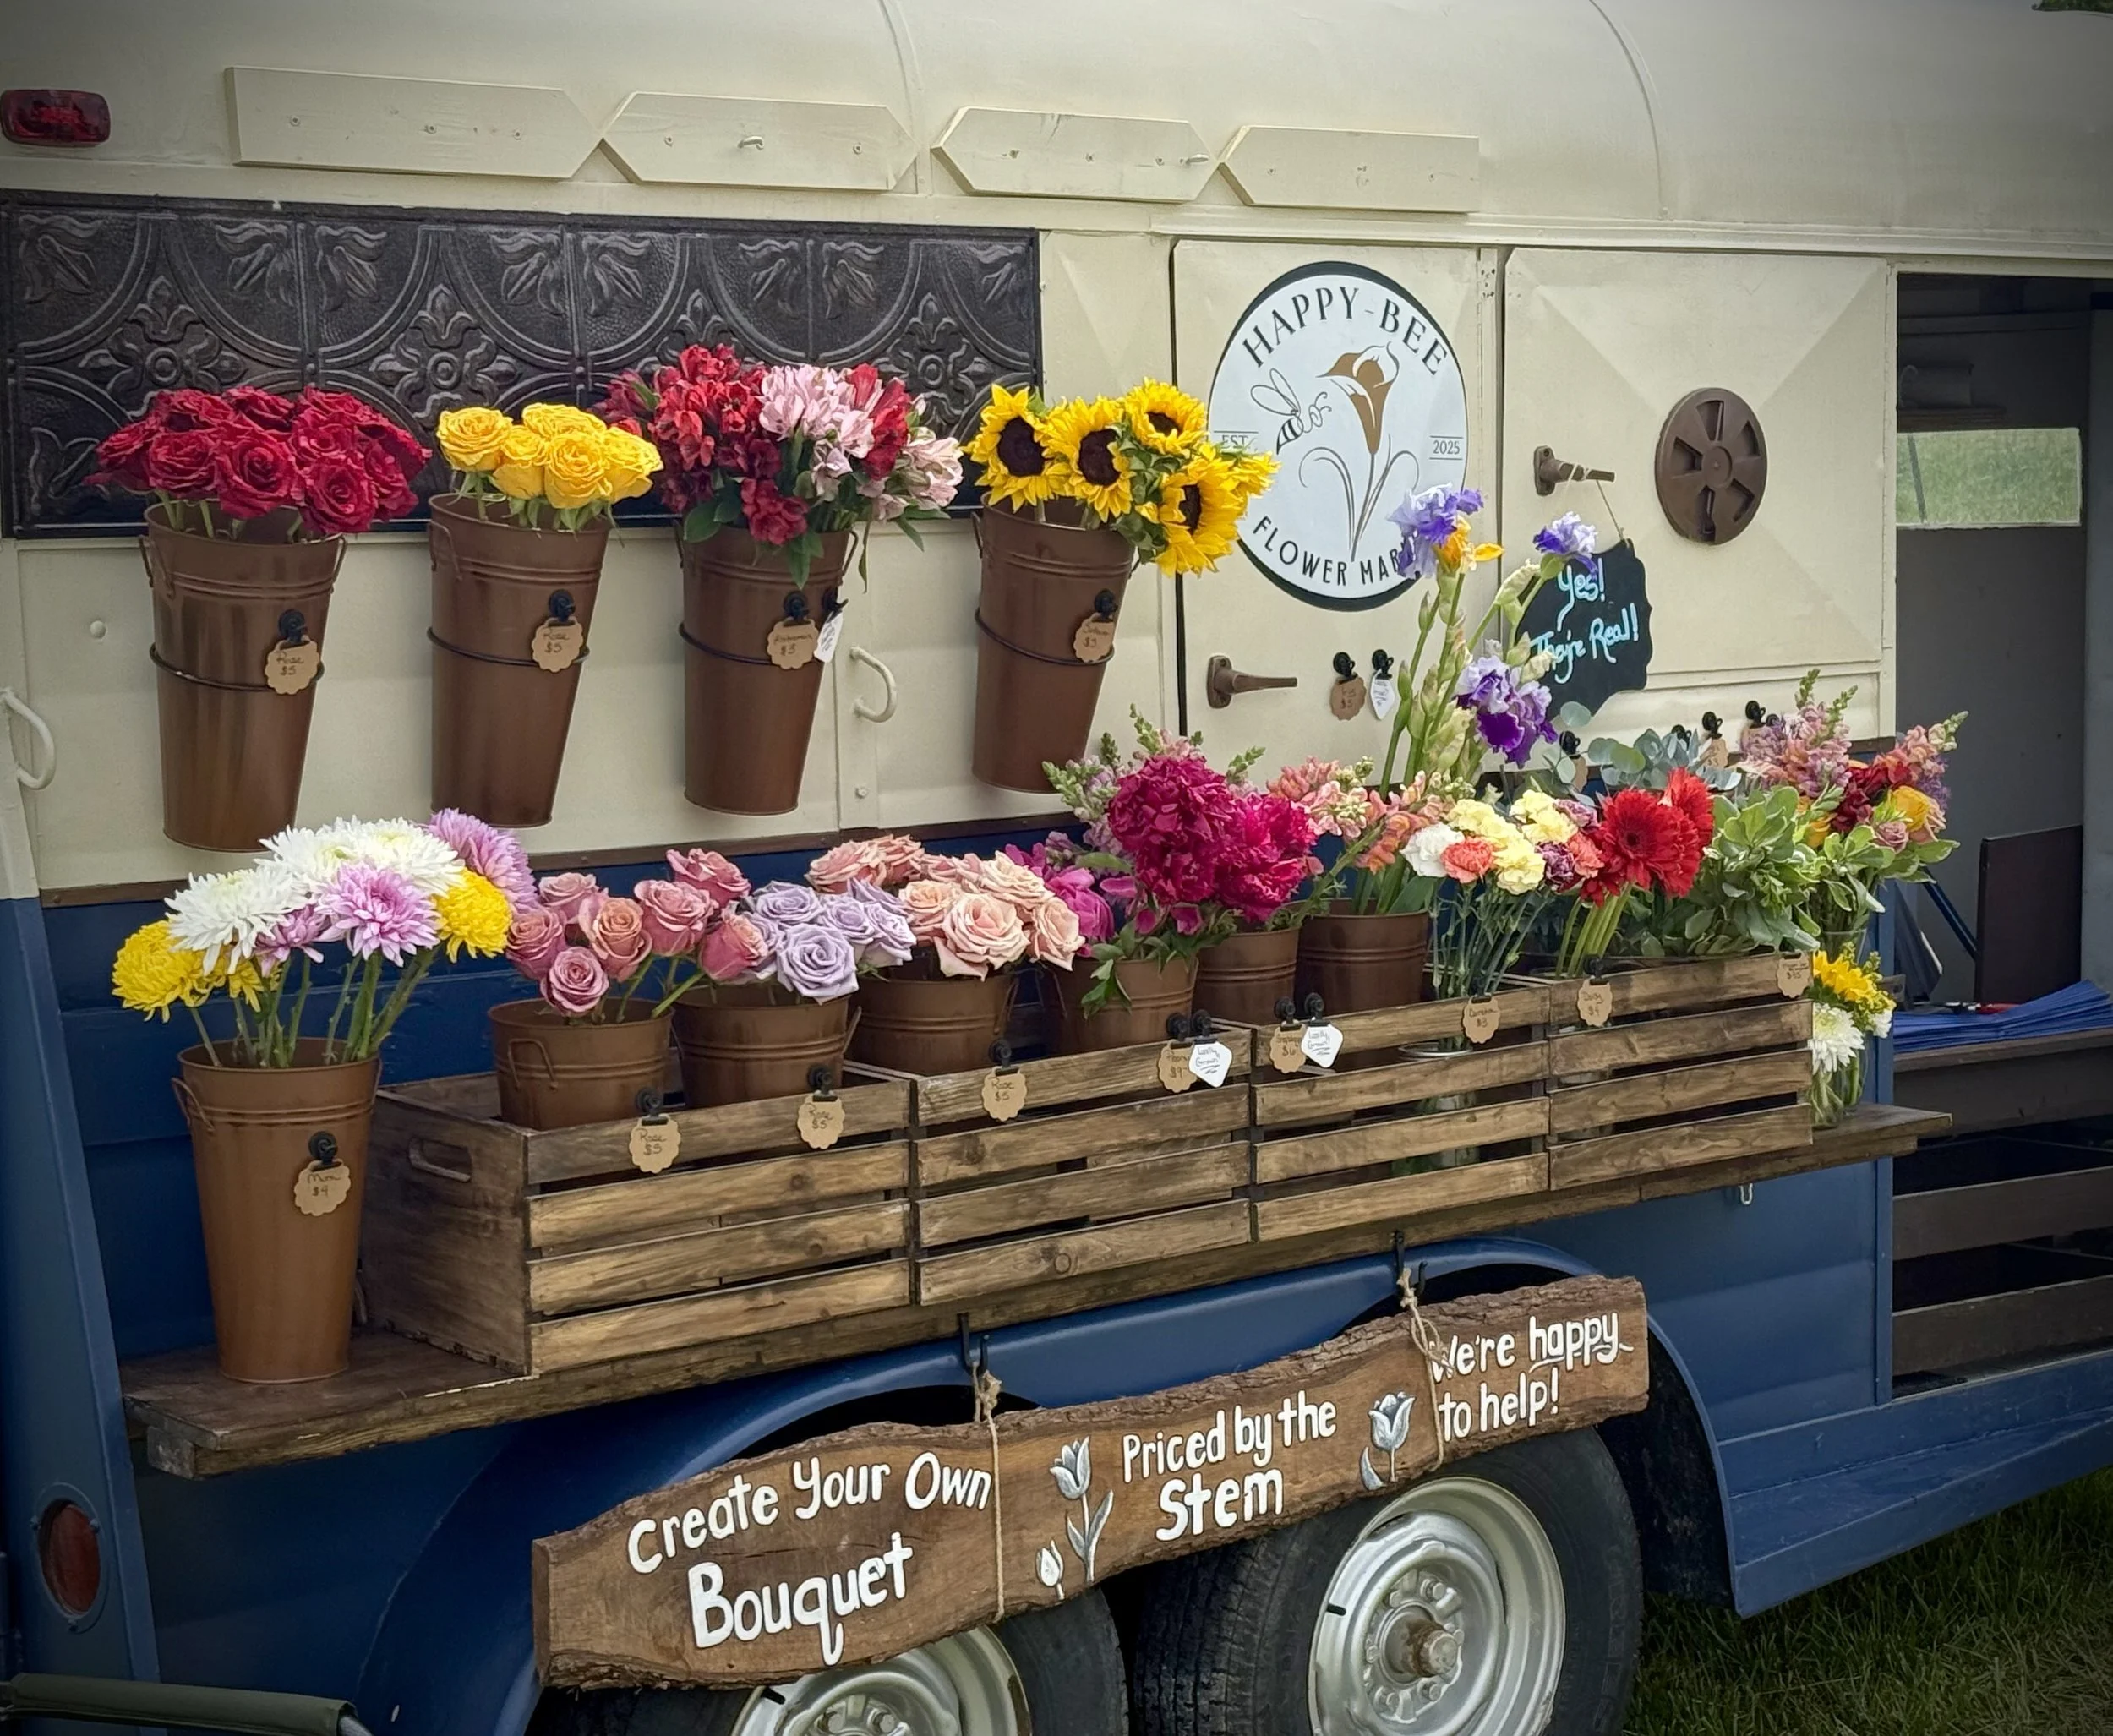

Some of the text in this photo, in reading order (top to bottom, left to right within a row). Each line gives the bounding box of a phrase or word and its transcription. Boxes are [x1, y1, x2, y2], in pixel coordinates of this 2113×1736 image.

[1433, 439, 1461, 455] 2025
[1253, 516, 1404, 586] FLOWER MAR
[1558, 558, 1605, 631] Yes!
[280, 665, 297, 676] $5
[545, 642, 562, 653] $5
[812, 1119, 827, 1130] $5
[995, 1091, 1010, 1102] $5
[635, 1127, 668, 1143] Rose
[643, 1144, 663, 1155] $5
[1429, 1312, 1623, 1383] We're happy
[1122, 1390, 1337, 1484] Priced by the
[1439, 1367, 1561, 1442] to help!
[627, 1451, 991, 1574] Create Your Own
[1155, 1466, 1284, 1542] Stem
[687, 1531, 914, 1666] Bouquet
